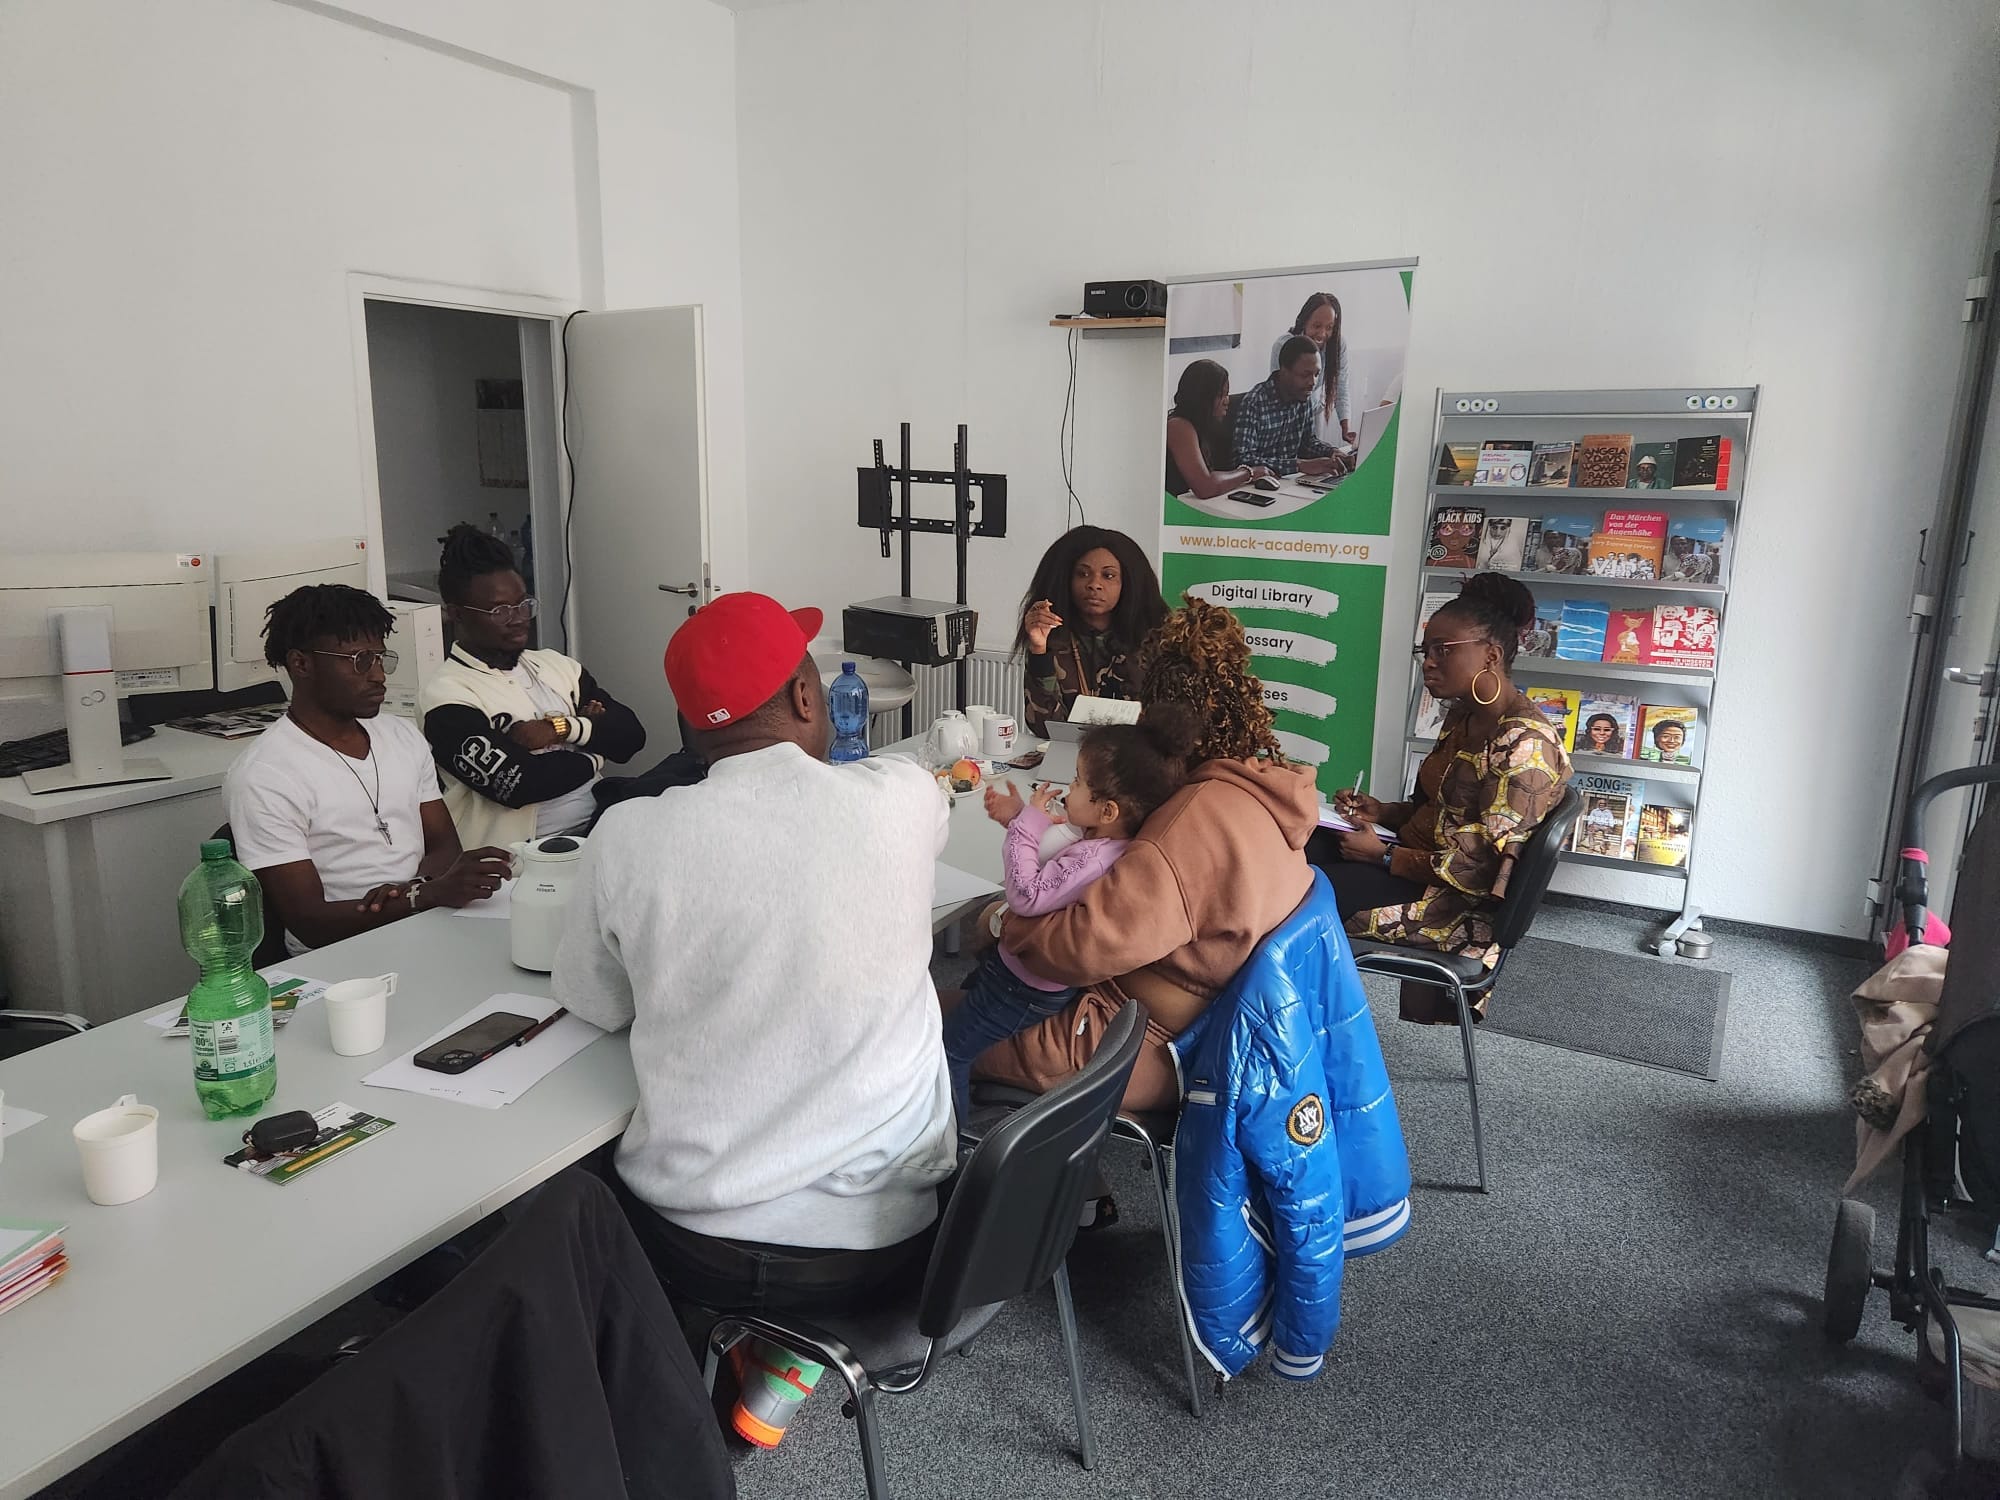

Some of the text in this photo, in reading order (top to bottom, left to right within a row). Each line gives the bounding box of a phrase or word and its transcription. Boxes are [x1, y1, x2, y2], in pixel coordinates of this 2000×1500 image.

[1584, 447, 1627, 455] ANGELA
[1582, 463, 1628, 472] WOMEN
[1588, 472, 1616, 480] RACE
[1437, 512, 1483, 524] BLACK KIDS
[1624, 521, 1639, 529] der
[1179, 535, 1370, 560] www.black-academy.org
[1211, 584, 1313, 608] Digital Library
[1245, 634, 1294, 653] ossary
[1578, 776, 1620, 791] A SONG
